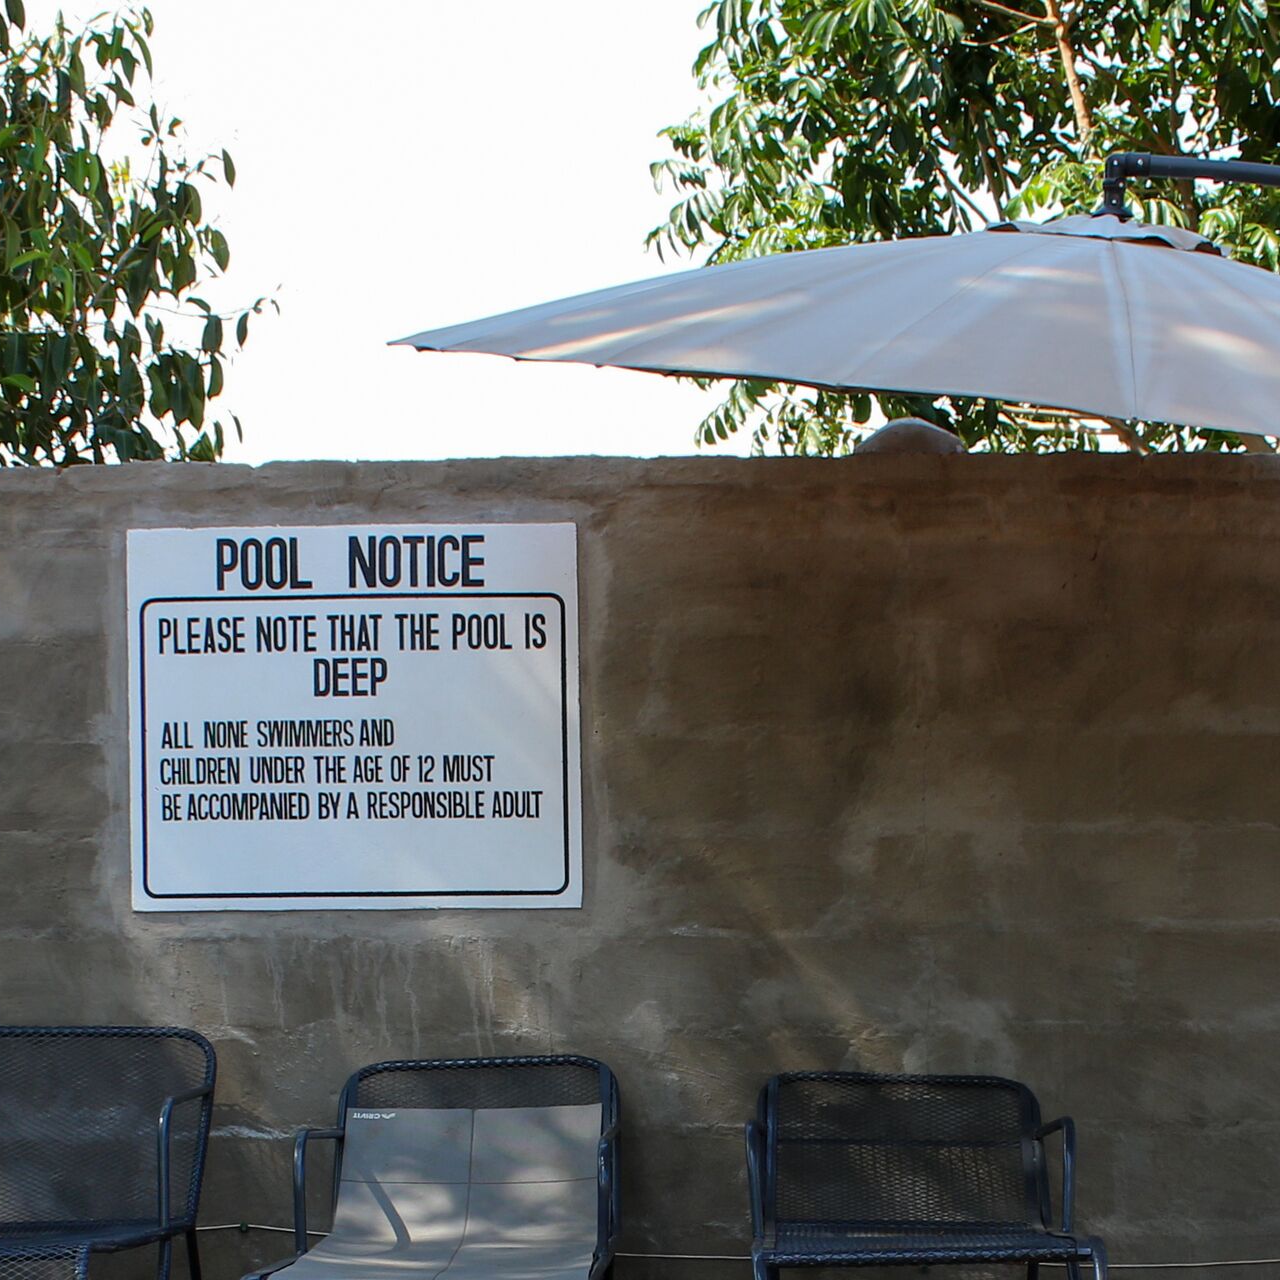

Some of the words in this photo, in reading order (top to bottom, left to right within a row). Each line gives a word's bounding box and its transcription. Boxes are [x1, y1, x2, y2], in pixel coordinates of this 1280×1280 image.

[217, 537, 312, 590] POOL
[349, 535, 484, 588] NOTICE
[159, 617, 245, 654] PLEASE
[256, 616, 316, 652] NOTE
[327, 614, 382, 651] THAT
[395, 614, 439, 650] THE
[452, 613, 512, 650] POOL
[525, 613, 546, 649] IS
[314, 658, 387, 696] DEEP
[162, 722, 193, 749] ALL
[204, 721, 248, 748] NONE
[257, 720, 354, 747] SWIMMERS
[360, 719, 394, 746] AND
[160, 757, 239, 785] CHILDREN
[250, 756, 304, 784] UNDER
[313, 756, 346, 783] THE
[353, 755, 383, 783] AGE
[391, 755, 410, 782] OF
[418, 755, 435, 782] 12
[443, 755, 495, 782] MUST
[162, 794, 182, 821] BE
[188, 792, 309, 820] ACCOMPANIED
[318, 792, 340, 819] BY
[347, 792, 359, 819] A
[367, 791, 485, 819] RESPONSIBLE
[492, 791, 543, 818] ADULT
